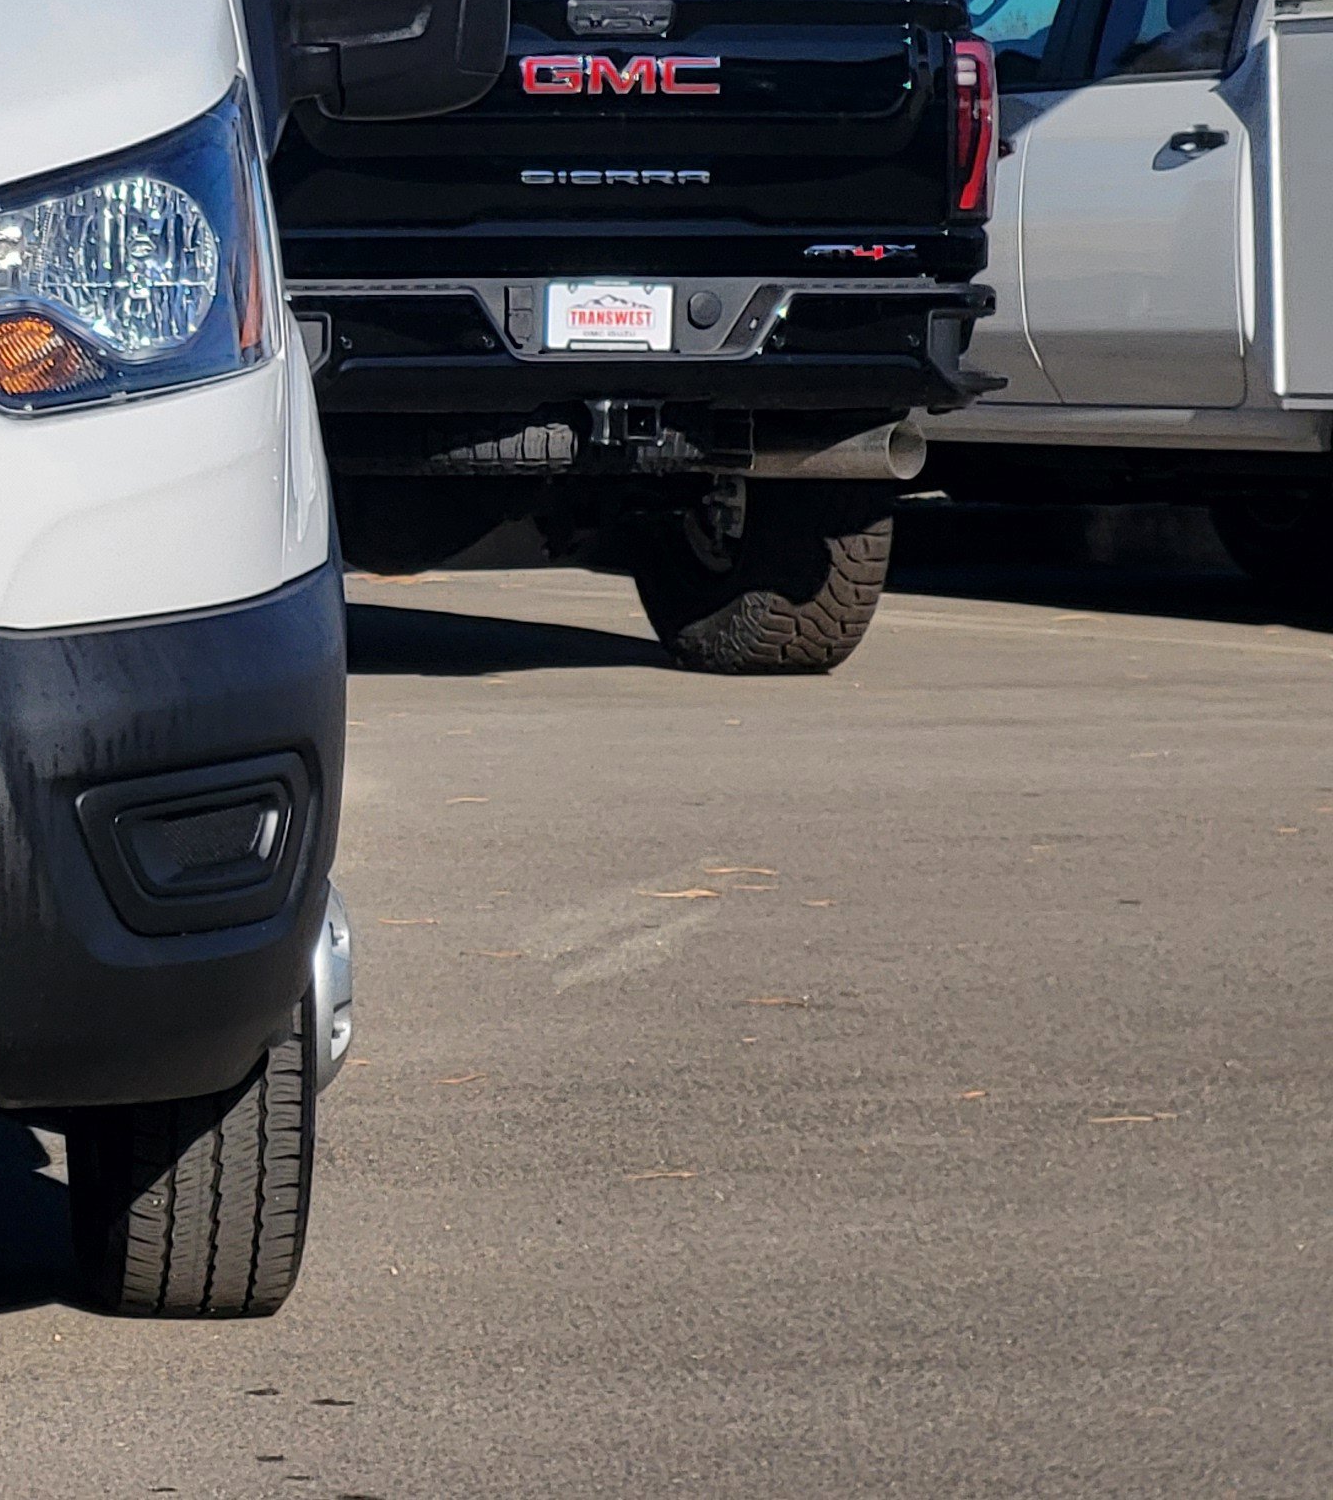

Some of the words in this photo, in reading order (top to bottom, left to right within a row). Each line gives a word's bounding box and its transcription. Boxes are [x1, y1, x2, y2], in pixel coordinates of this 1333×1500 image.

[520, 55, 721, 95] GMC
[520, 170, 711, 185] SIERRA
[570, 310, 653, 326] TRANSWEST
